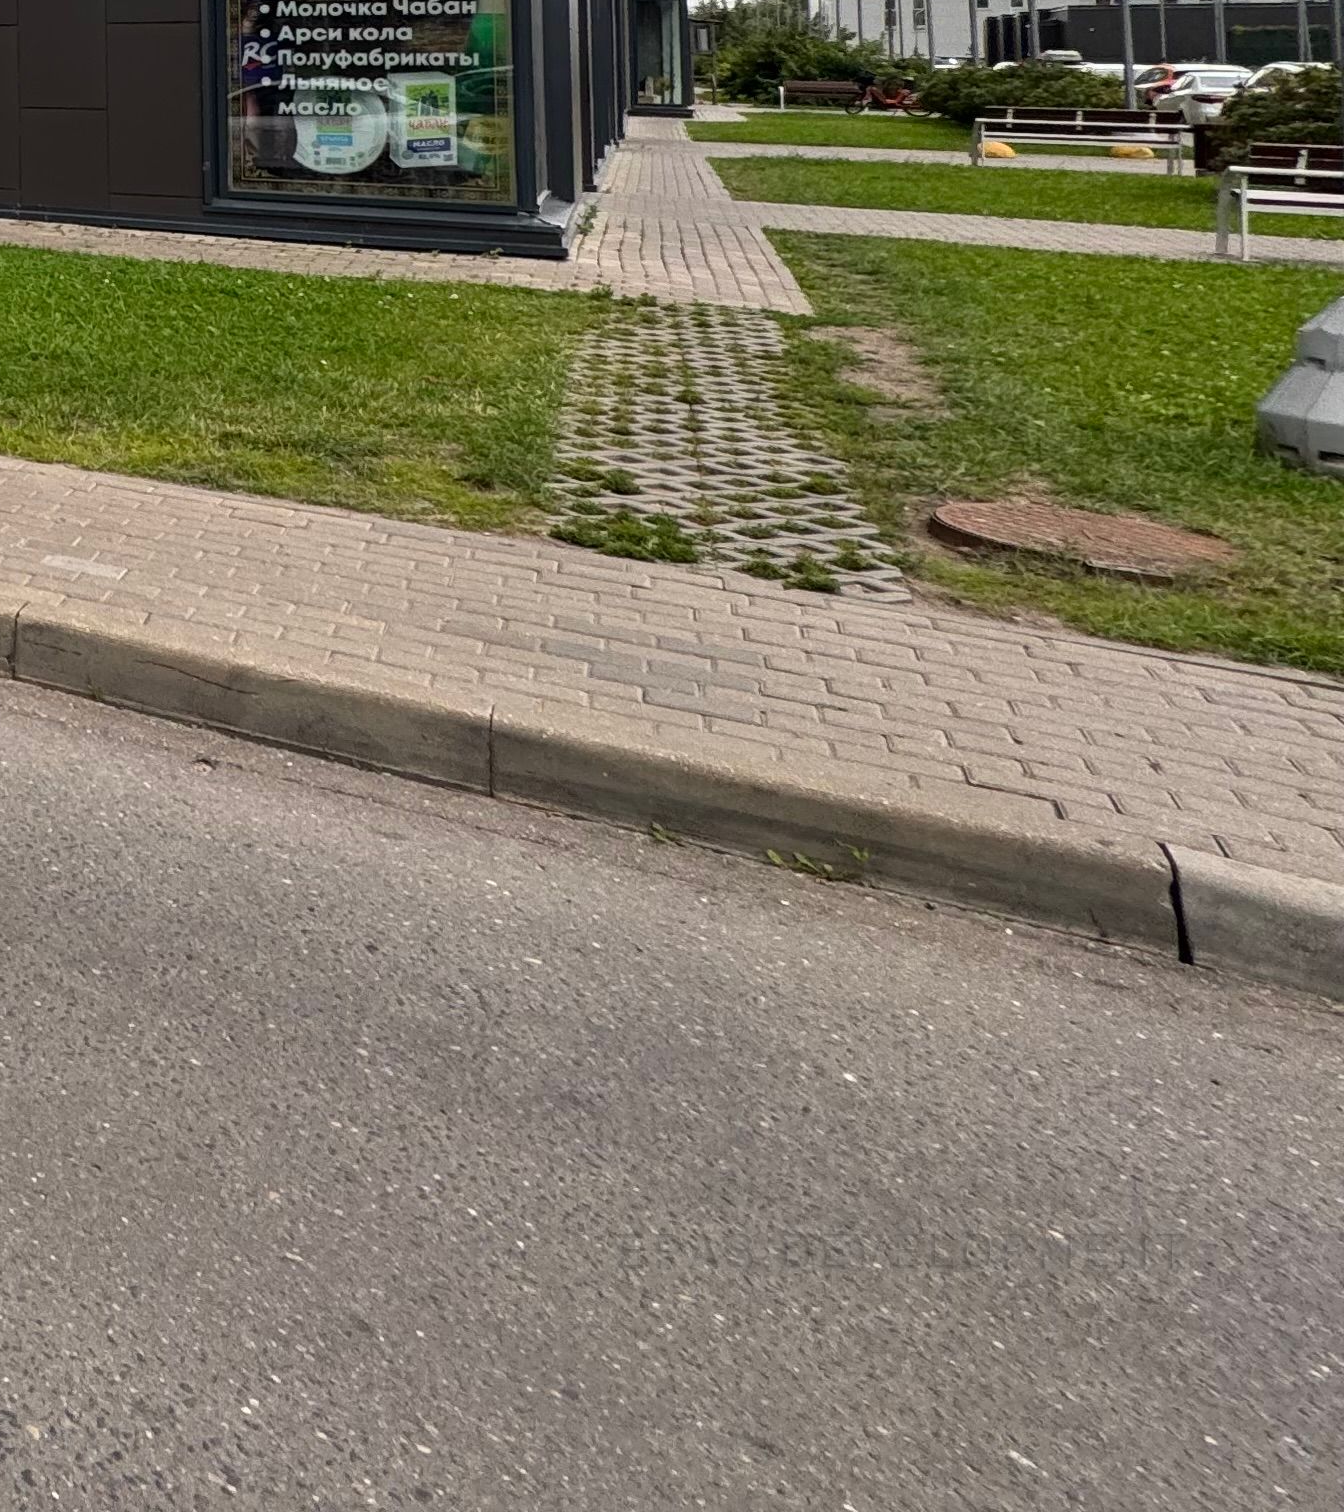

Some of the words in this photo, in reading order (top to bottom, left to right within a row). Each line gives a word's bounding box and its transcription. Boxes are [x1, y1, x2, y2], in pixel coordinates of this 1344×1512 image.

[276, 0, 388, 18] Молочка
[277, 25, 343, 46] Арси
[349, 25, 414, 42] кола
[277, 46, 481, 70] Полуфабрикаты
[278, 73, 390, 91] Льняное
[277, 101, 363, 116] масло
